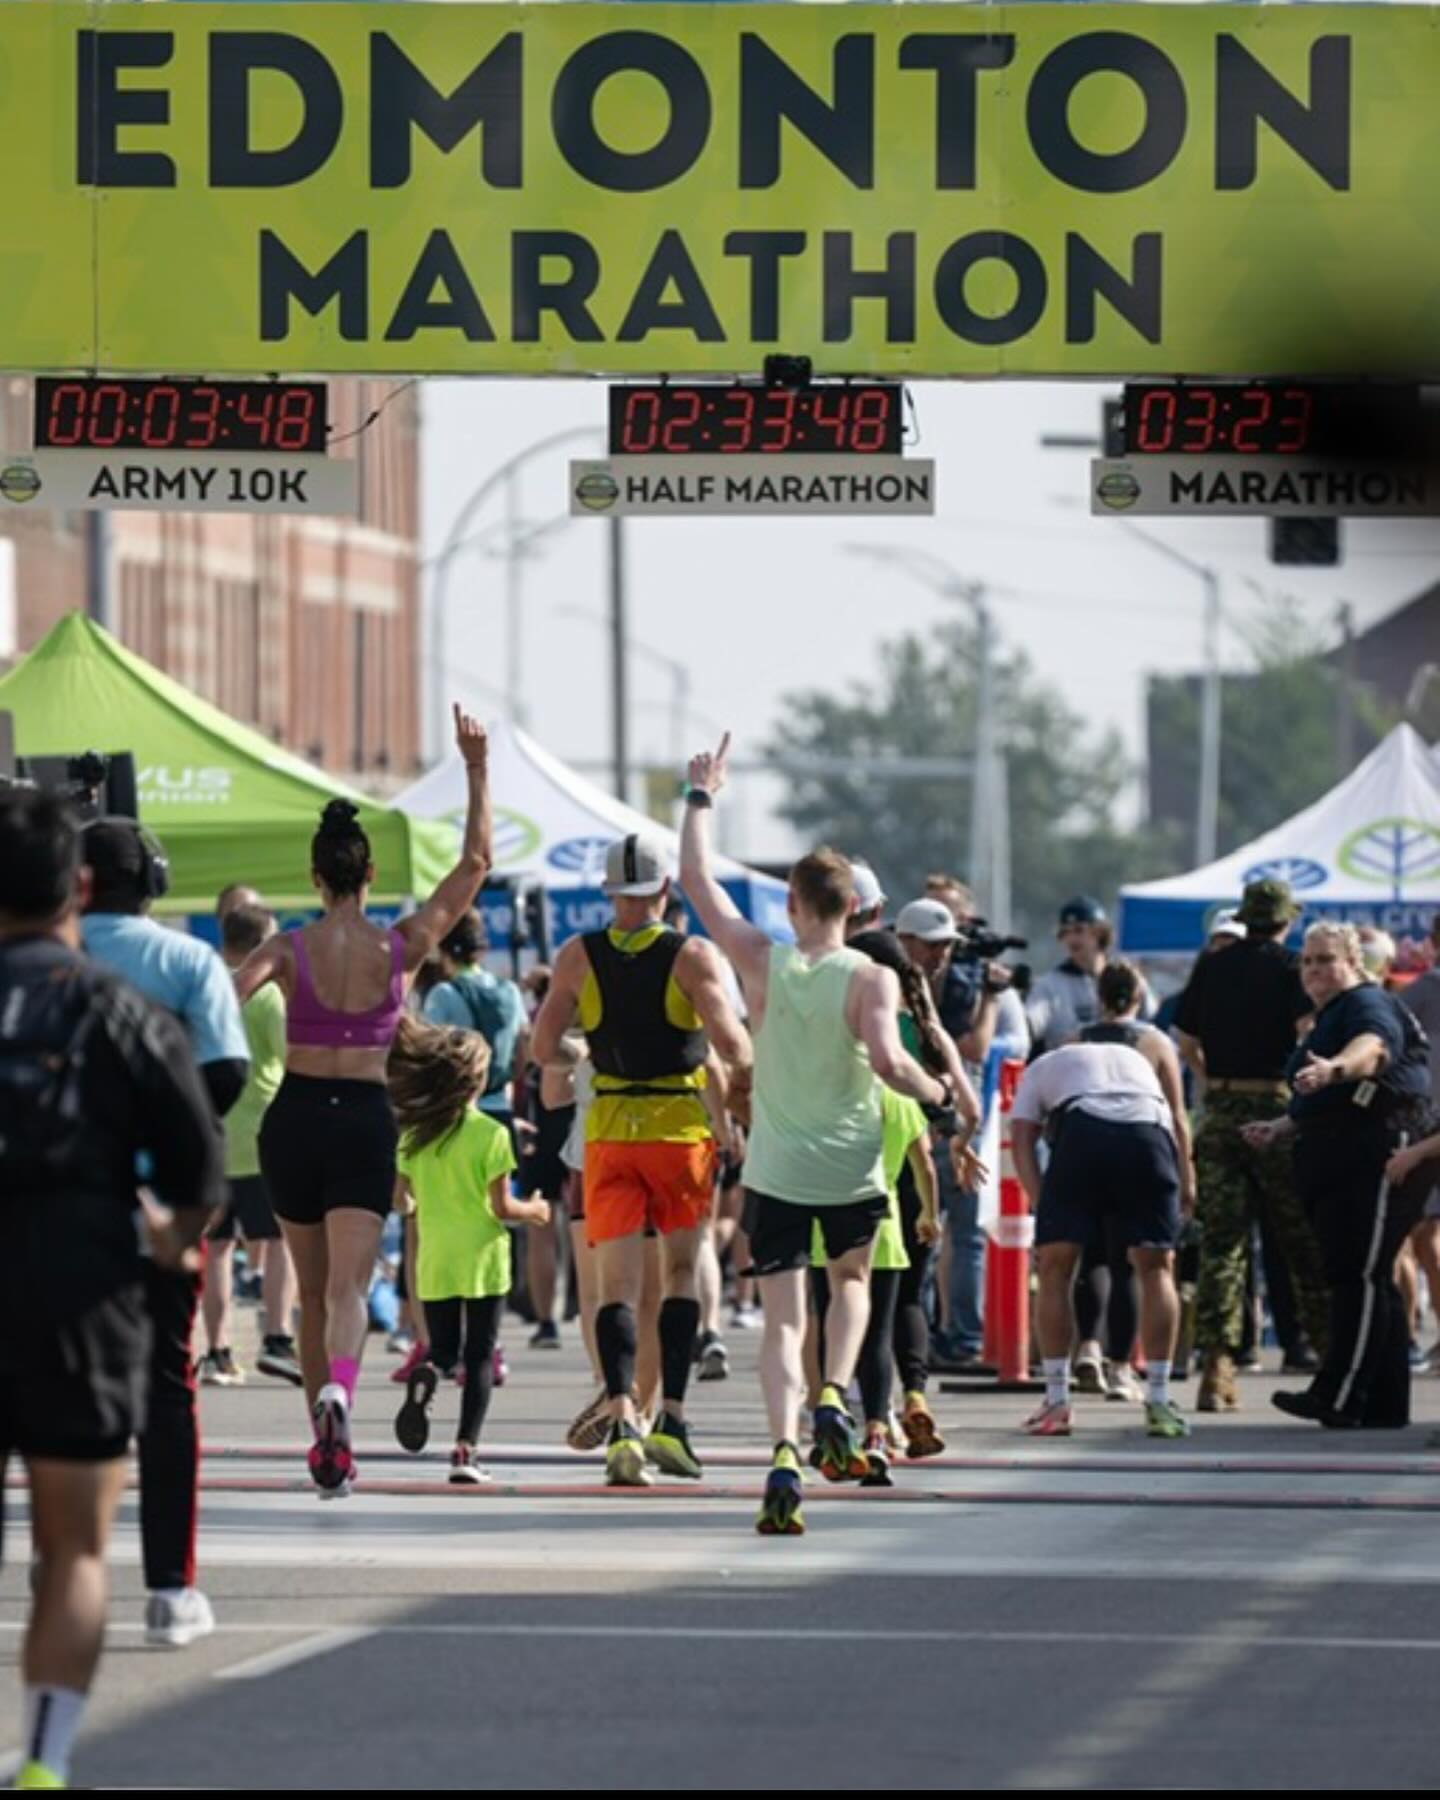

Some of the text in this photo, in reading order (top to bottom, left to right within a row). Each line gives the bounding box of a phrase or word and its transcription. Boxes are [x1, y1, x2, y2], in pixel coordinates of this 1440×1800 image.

[77, 29, 1351, 193] EDMONTON
[260, 229, 1162, 345] MARATHON
[48, 384, 314, 450] 00:03:48
[623, 391, 888, 452] 02:33:48
[88, 466, 308, 503] ARMY 10K
[625, 475, 930, 504] HALF MARATHON
[1170, 471, 1426, 505] MARATHON
